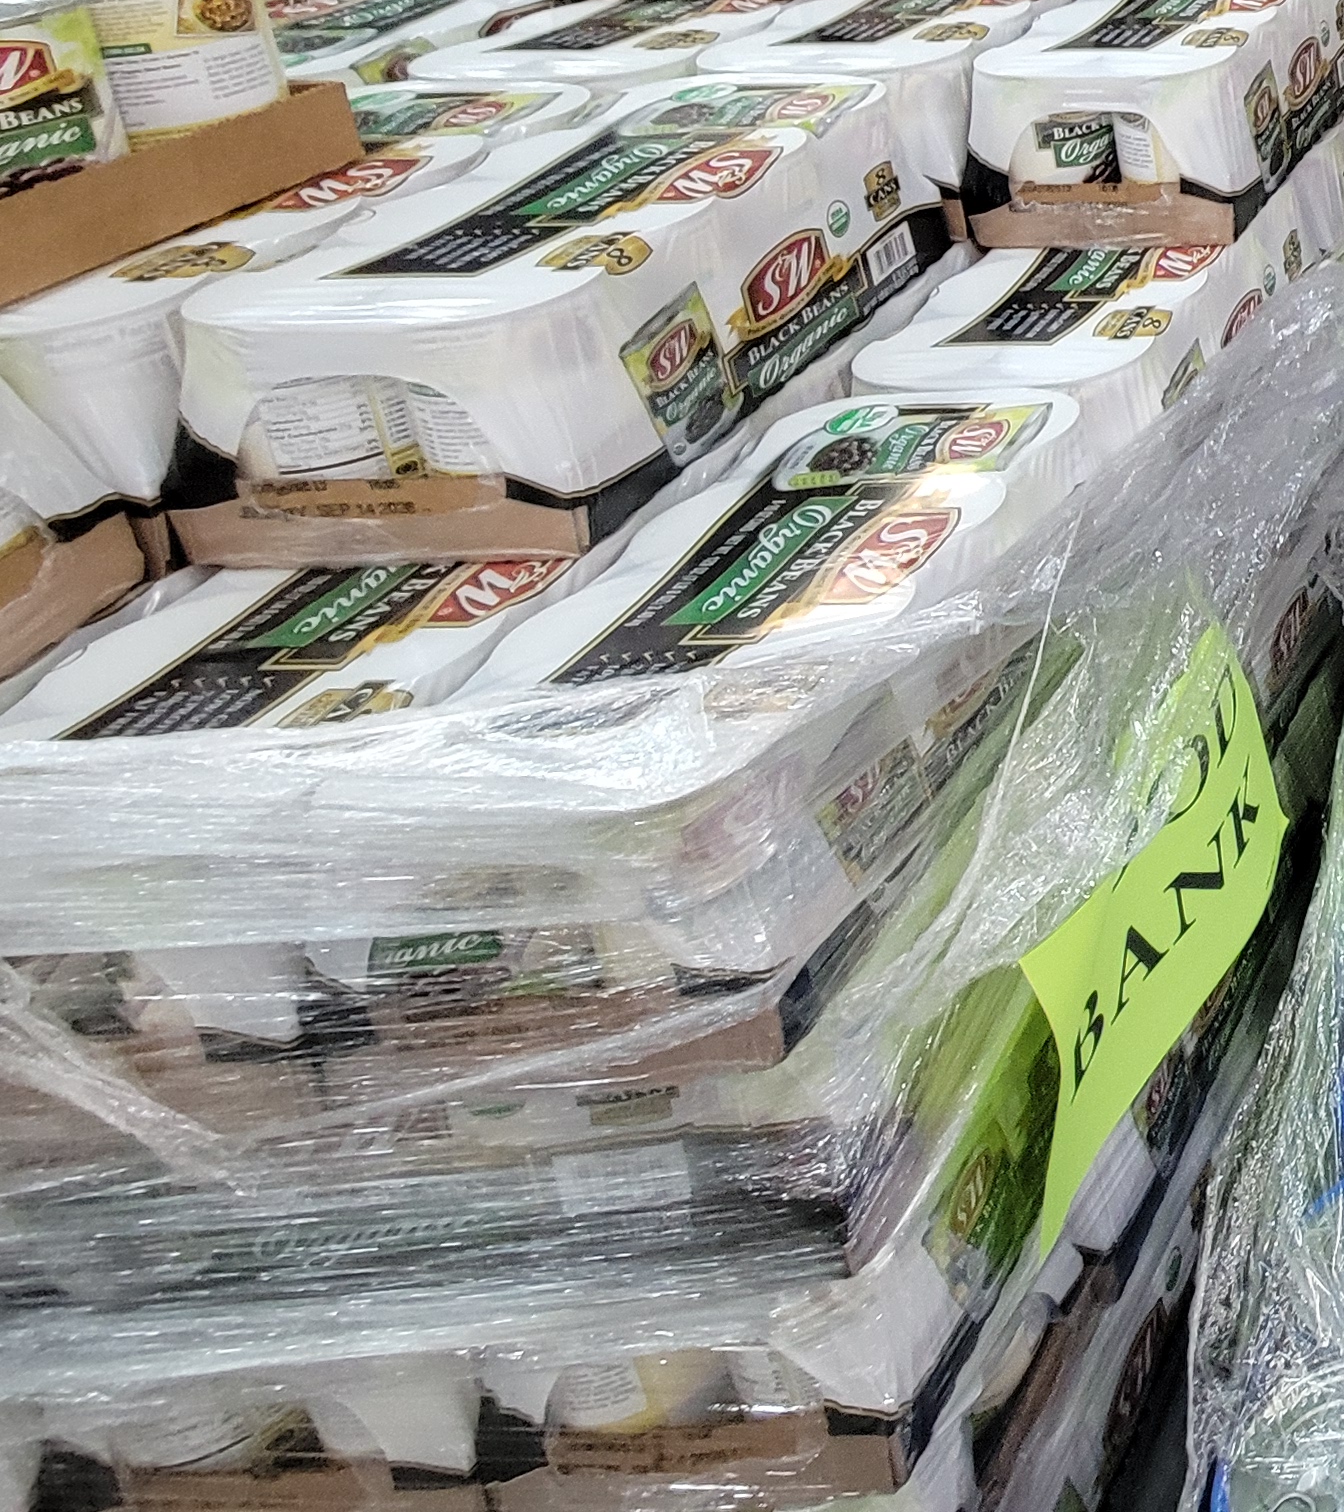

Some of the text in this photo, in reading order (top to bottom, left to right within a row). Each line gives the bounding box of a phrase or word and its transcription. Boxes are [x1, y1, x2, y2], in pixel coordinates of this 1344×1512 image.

[0, 97, 83, 130] BEANS
[546, 142, 669, 209] Organic
[671, 151, 754, 197] S&W
[868, 180, 898, 206] CANS
[875, 168, 886, 180] 8
[606, 247, 634, 268] 8
[757, 233, 816, 316] S&W
[657, 327, 691, 380] S&W
[748, 281, 849, 366] BLACK BEANS
[760, 305, 848, 389] Organic
[656, 381, 686, 408] BLACK
[701, 503, 834, 613] Organic
[808, 498, 885, 563] BLACK
[736, 554, 818, 620] BEANS
[1072, 753, 1261, 1104] BANK
